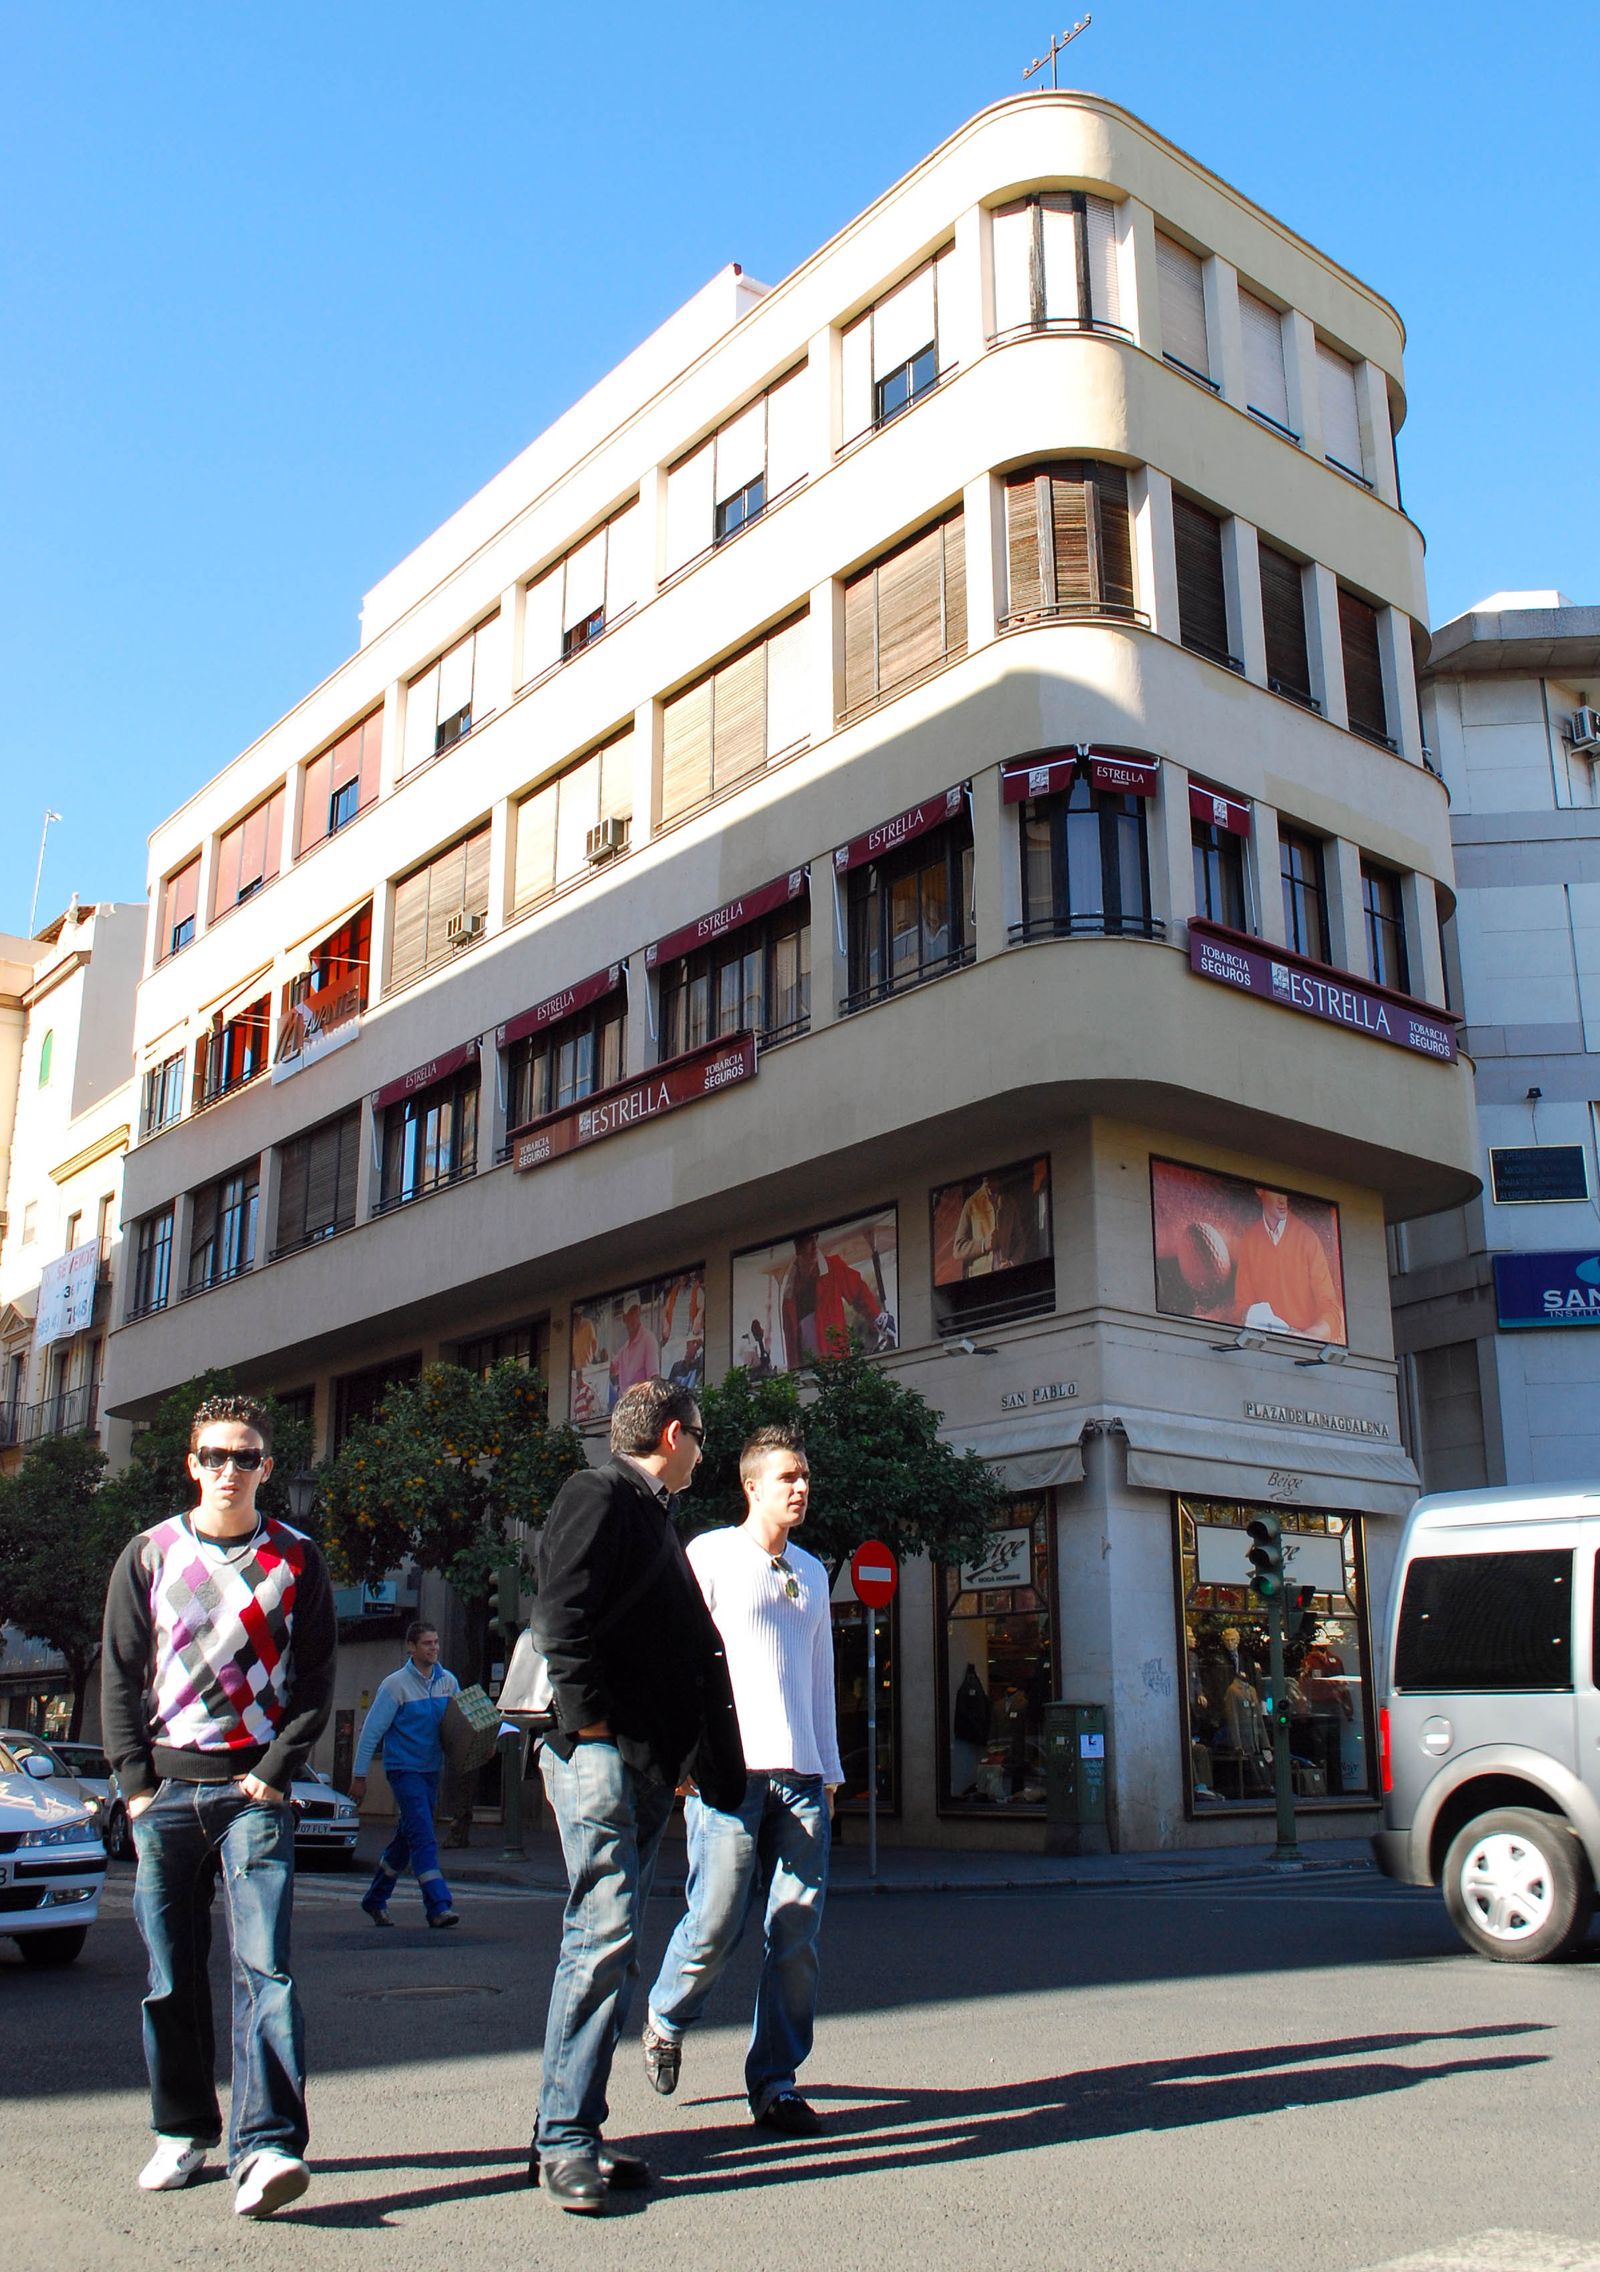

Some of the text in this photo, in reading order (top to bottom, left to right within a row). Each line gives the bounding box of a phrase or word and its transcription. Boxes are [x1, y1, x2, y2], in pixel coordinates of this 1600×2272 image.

[1096, 766, 1145, 784] ESTRELLA
[868, 809, 924, 850] ESTRELLA
[698, 902, 743, 937] ESTRELLA
[1200, 943, 1249, 971] TOBARCIA
[1200, 957, 1251, 986] SEGUROS
[537, 990, 575, 1021] ESTRELLA
[1290, 973, 1391, 1036] ESTRELLA
[1408, 1020, 1449, 1044] TOBARCIA
[1409, 1033, 1451, 1057] SEGUROS
[405, 1062, 437, 1088] ESTRELLA
[704, 1052, 743, 1077] TOBARCIA
[704, 1063, 744, 1090] SEGUROS
[591, 1081, 670, 1136] ESTRELLA
[518, 1146, 550, 1168] SEGUROS
[519, 1136, 550, 1155] TOBARCIA
[1001, 1383, 1076, 1408] SAN PABLO
[1246, 1402, 1389, 1437] PLAZA DE LA MAGDALENA
[1267, 1471, 1303, 1497] Beige
